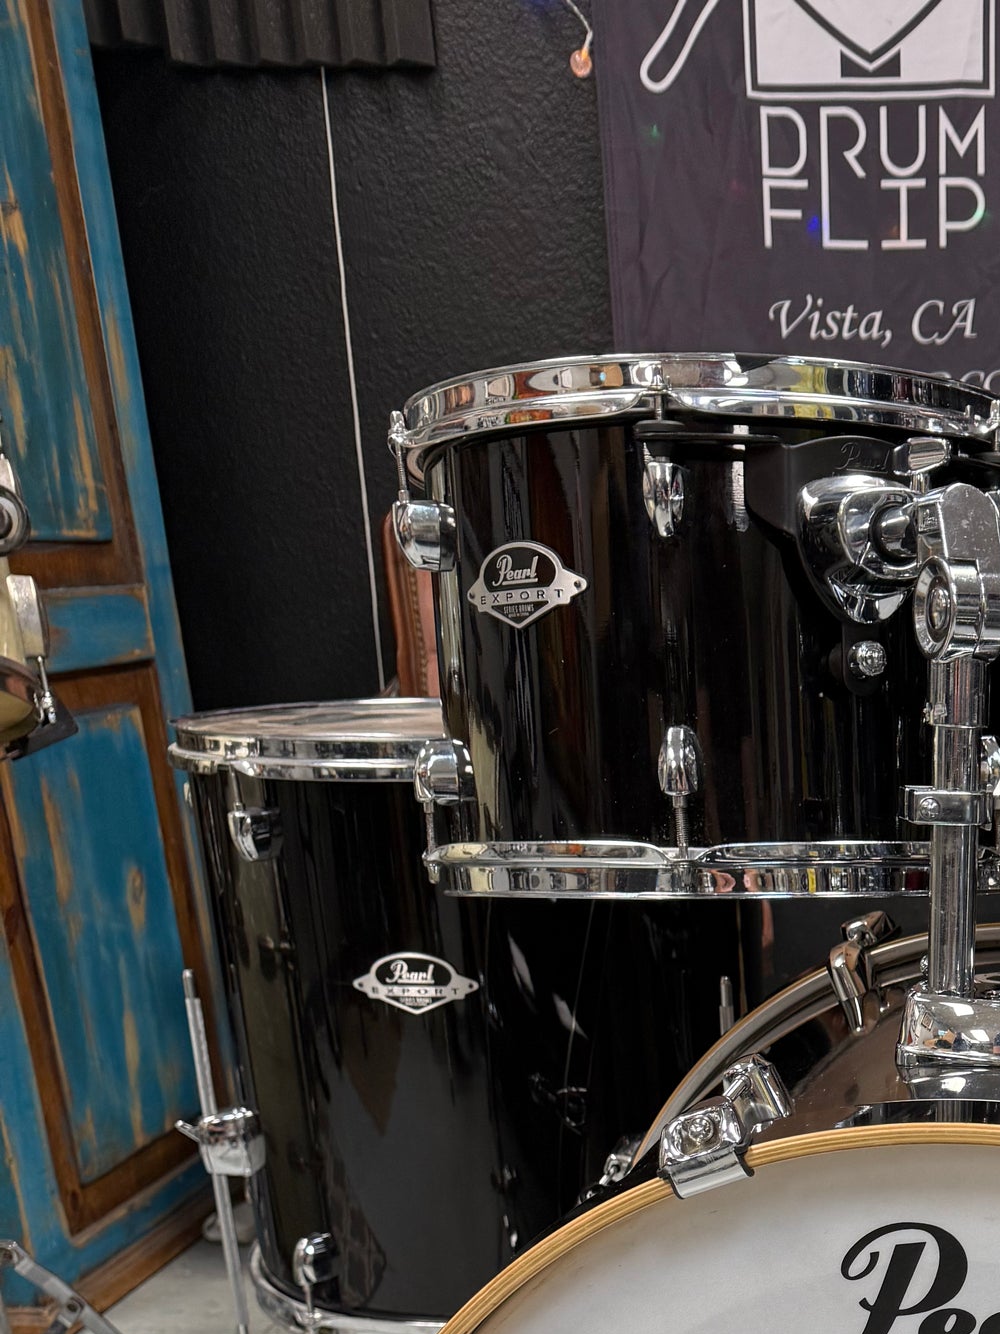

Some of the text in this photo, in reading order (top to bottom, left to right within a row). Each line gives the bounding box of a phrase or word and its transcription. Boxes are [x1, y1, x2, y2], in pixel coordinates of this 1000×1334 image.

[760, 105, 986, 178] DRUM
[762, 176, 987, 250] FLIP
[769, 294, 978, 348] Vista, CA
[492, 554, 539, 587] Pearl
[480, 589, 564, 605] EXPORT
[385, 960, 435, 984] Pearl
[371, 986, 460, 996] EXPORT
